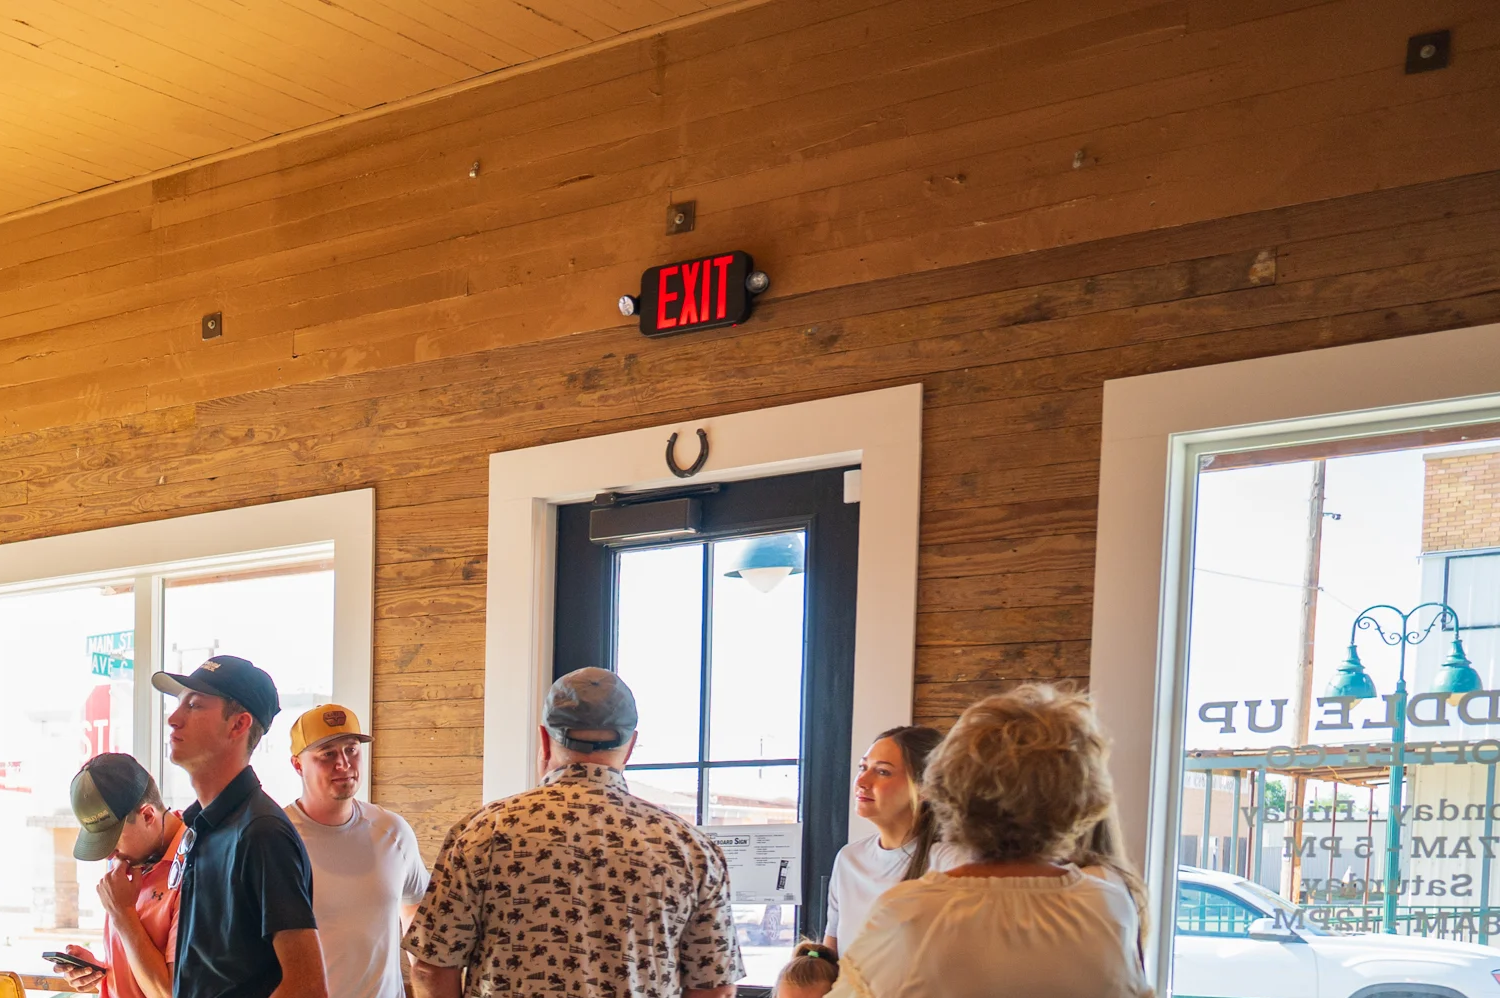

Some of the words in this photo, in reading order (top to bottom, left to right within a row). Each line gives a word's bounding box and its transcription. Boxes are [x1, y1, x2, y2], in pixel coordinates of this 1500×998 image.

[656, 254, 734, 330] EXIT
[88, 634, 115, 655] MAIN
[118, 631, 134, 651] ST
[91, 654, 116, 678] AVE
